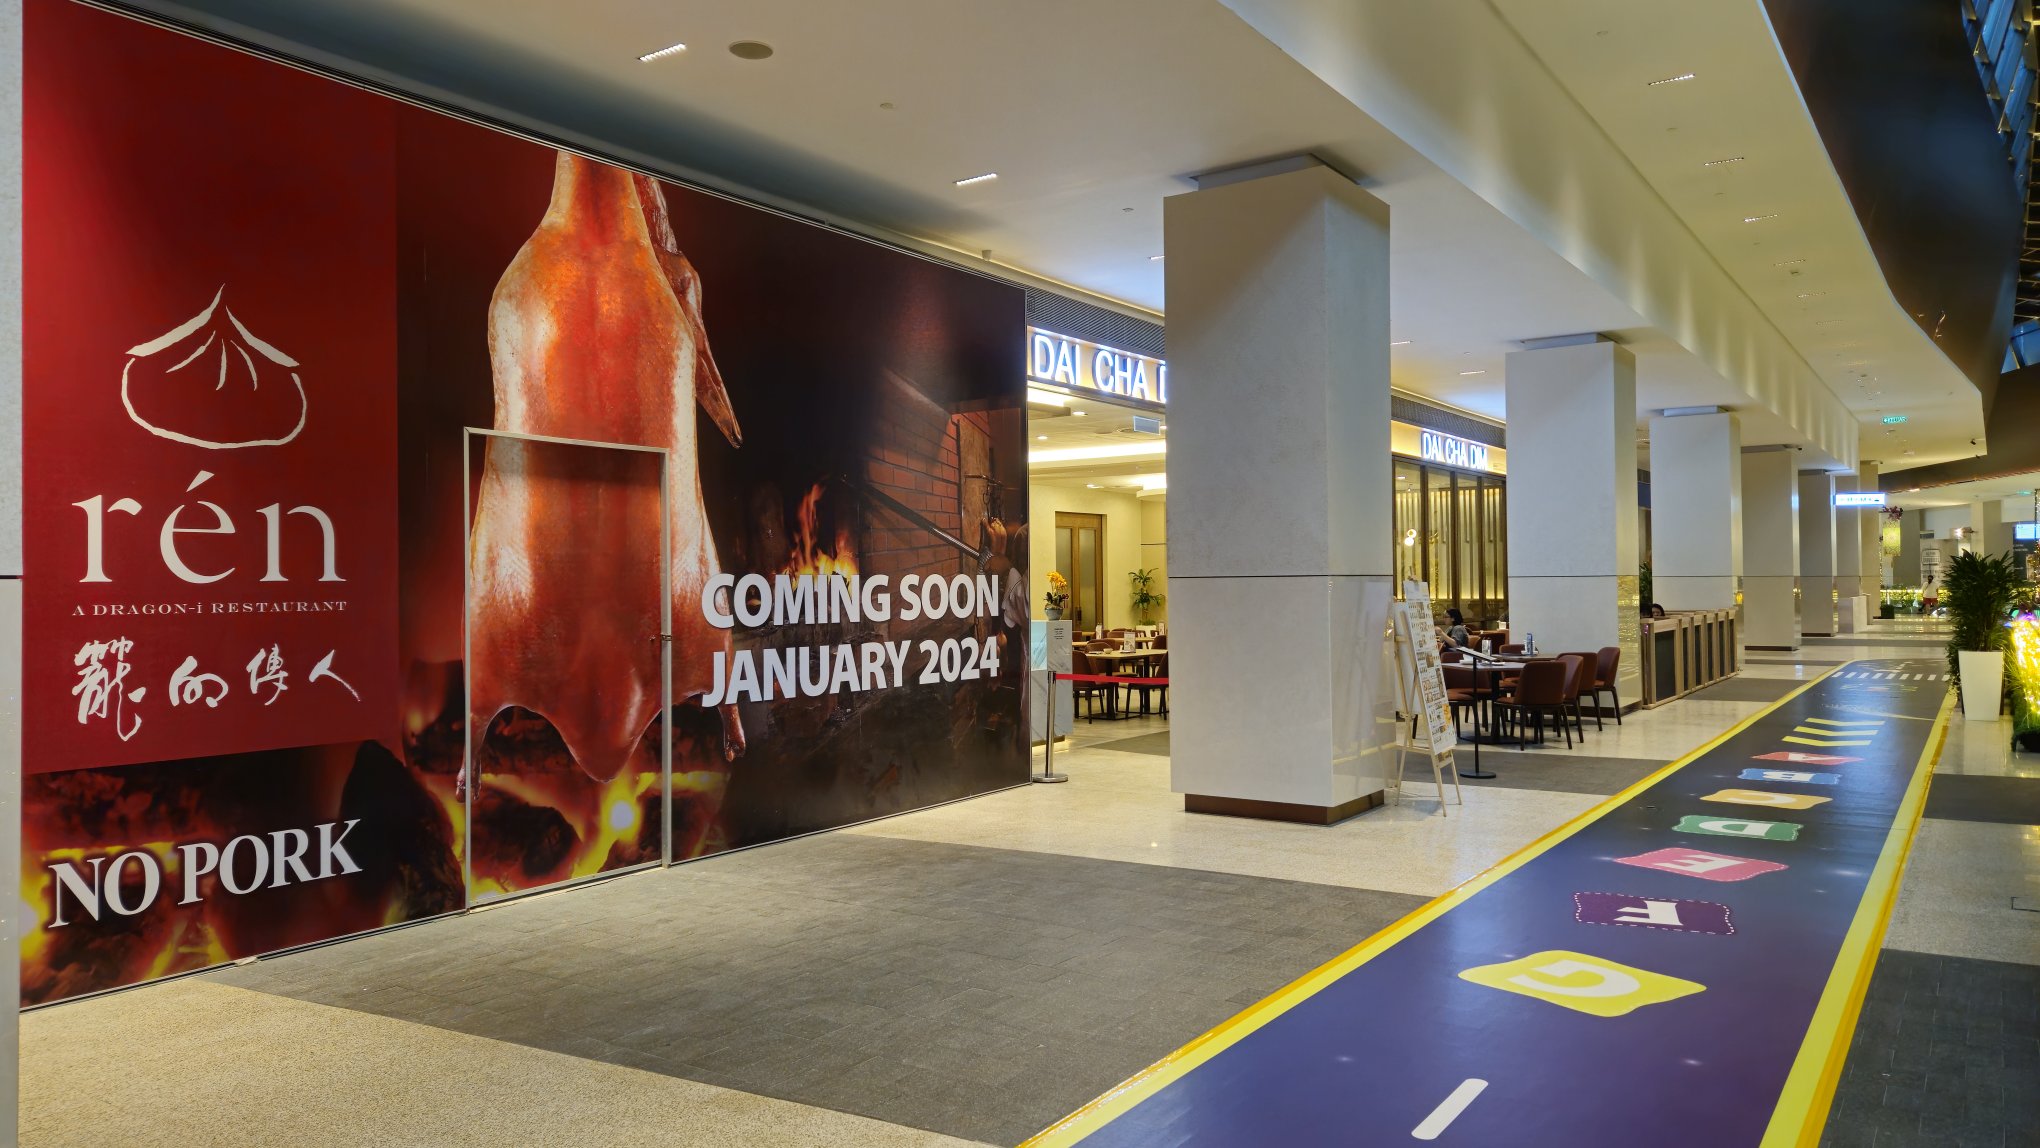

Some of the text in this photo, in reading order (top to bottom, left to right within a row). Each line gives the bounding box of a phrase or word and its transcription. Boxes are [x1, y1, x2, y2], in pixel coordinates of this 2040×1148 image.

[1034, 334, 1081, 385] DAI
[1095, 350, 1151, 400] CHA
[1422, 432, 1488, 471] DAI CHA DIM
[72, 470, 347, 584] rén
[72, 605, 85, 616] A
[211, 601, 347, 614] RESTAURANT
[701, 573, 1000, 629] COMING SOON
[702, 636, 1000, 708] JANUARY 2024
[1698, 820, 1777, 837] D
[49, 819, 362, 928] NO PORK
[1653, 854, 1746, 873] E
[1615, 900, 1683, 926] F
[1507, 959, 1640, 998] G
